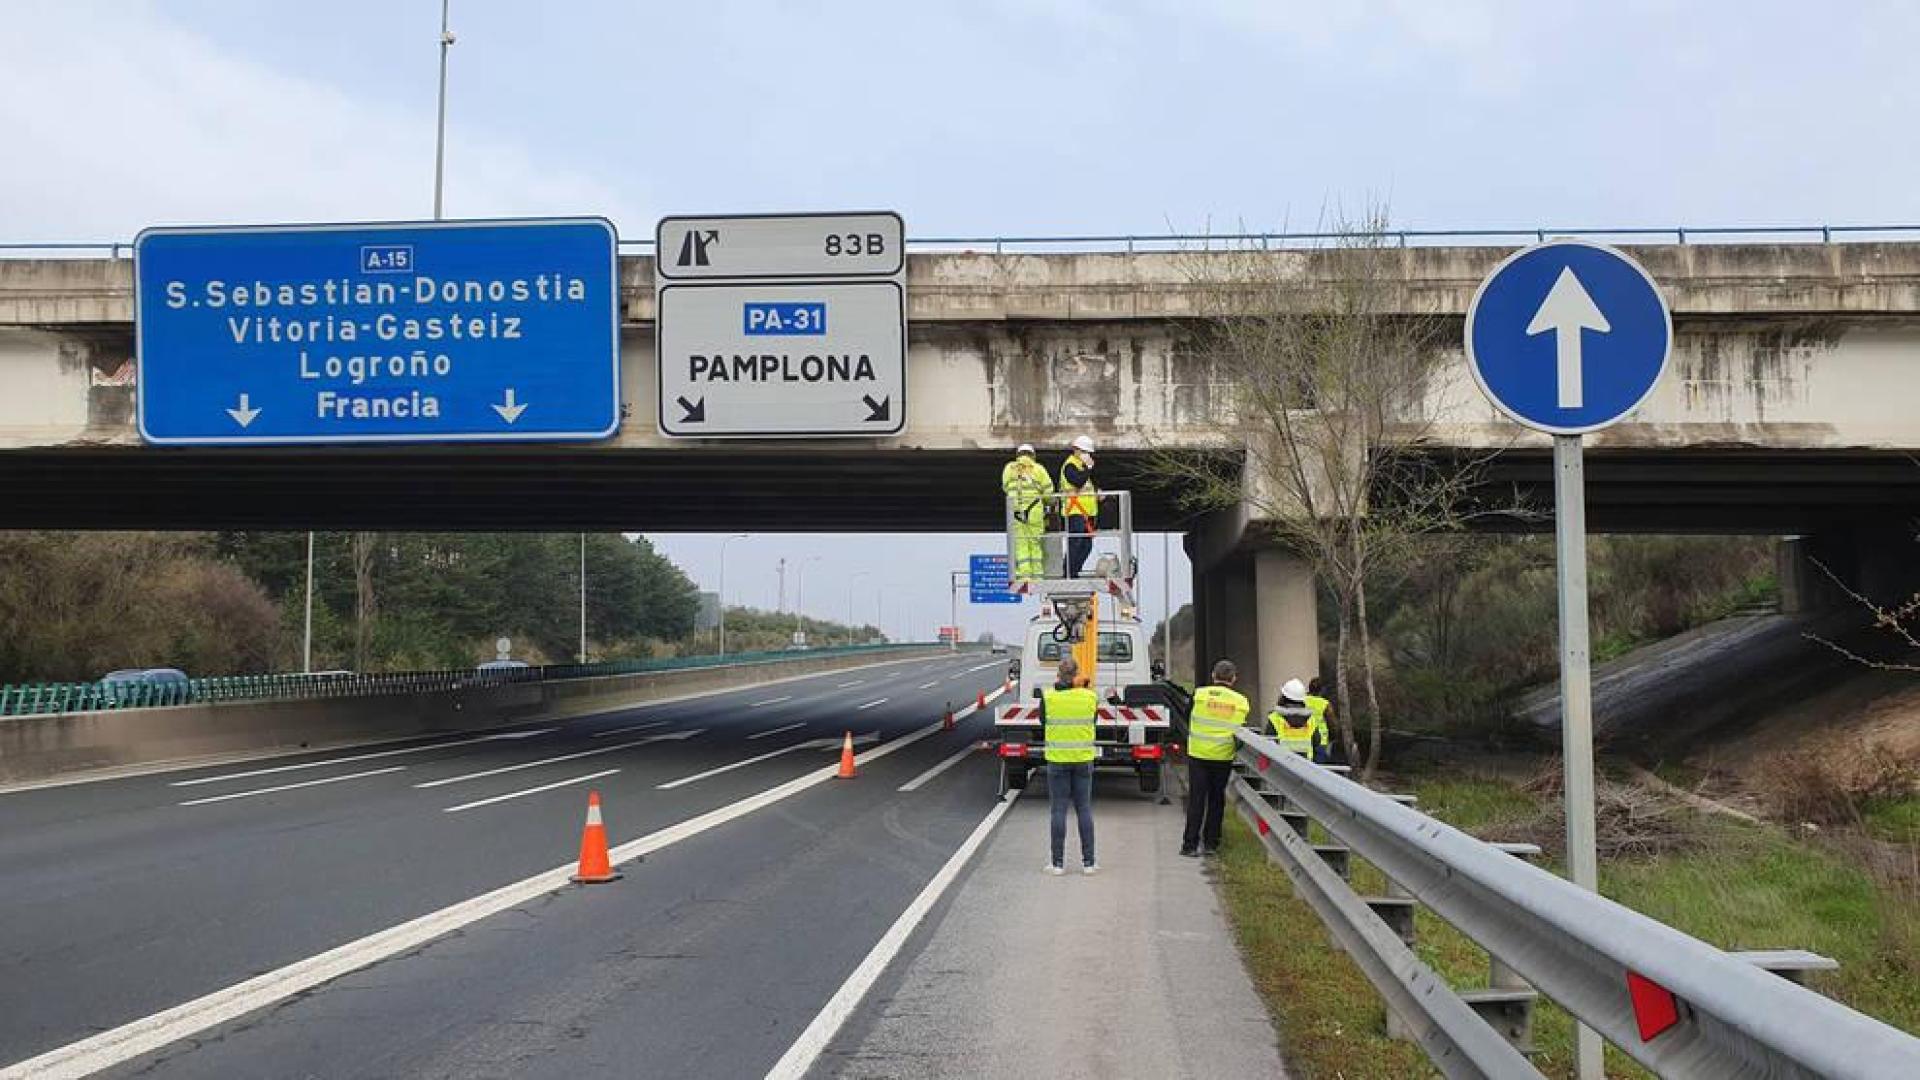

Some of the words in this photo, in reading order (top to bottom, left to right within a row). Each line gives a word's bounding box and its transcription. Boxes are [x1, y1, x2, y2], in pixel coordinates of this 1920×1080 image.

[825, 234, 885, 256] 83B
[368, 251, 406, 267] A-15
[166, 275, 586, 308] S.Sebastian-Donostia
[229, 313, 522, 343] Vitoria-Gasteiz
[750, 308, 822, 330] PA-31
[300, 350, 451, 385] Logroño
[689, 354, 876, 382] PAMPLONA
[317, 391, 440, 418] Francia
